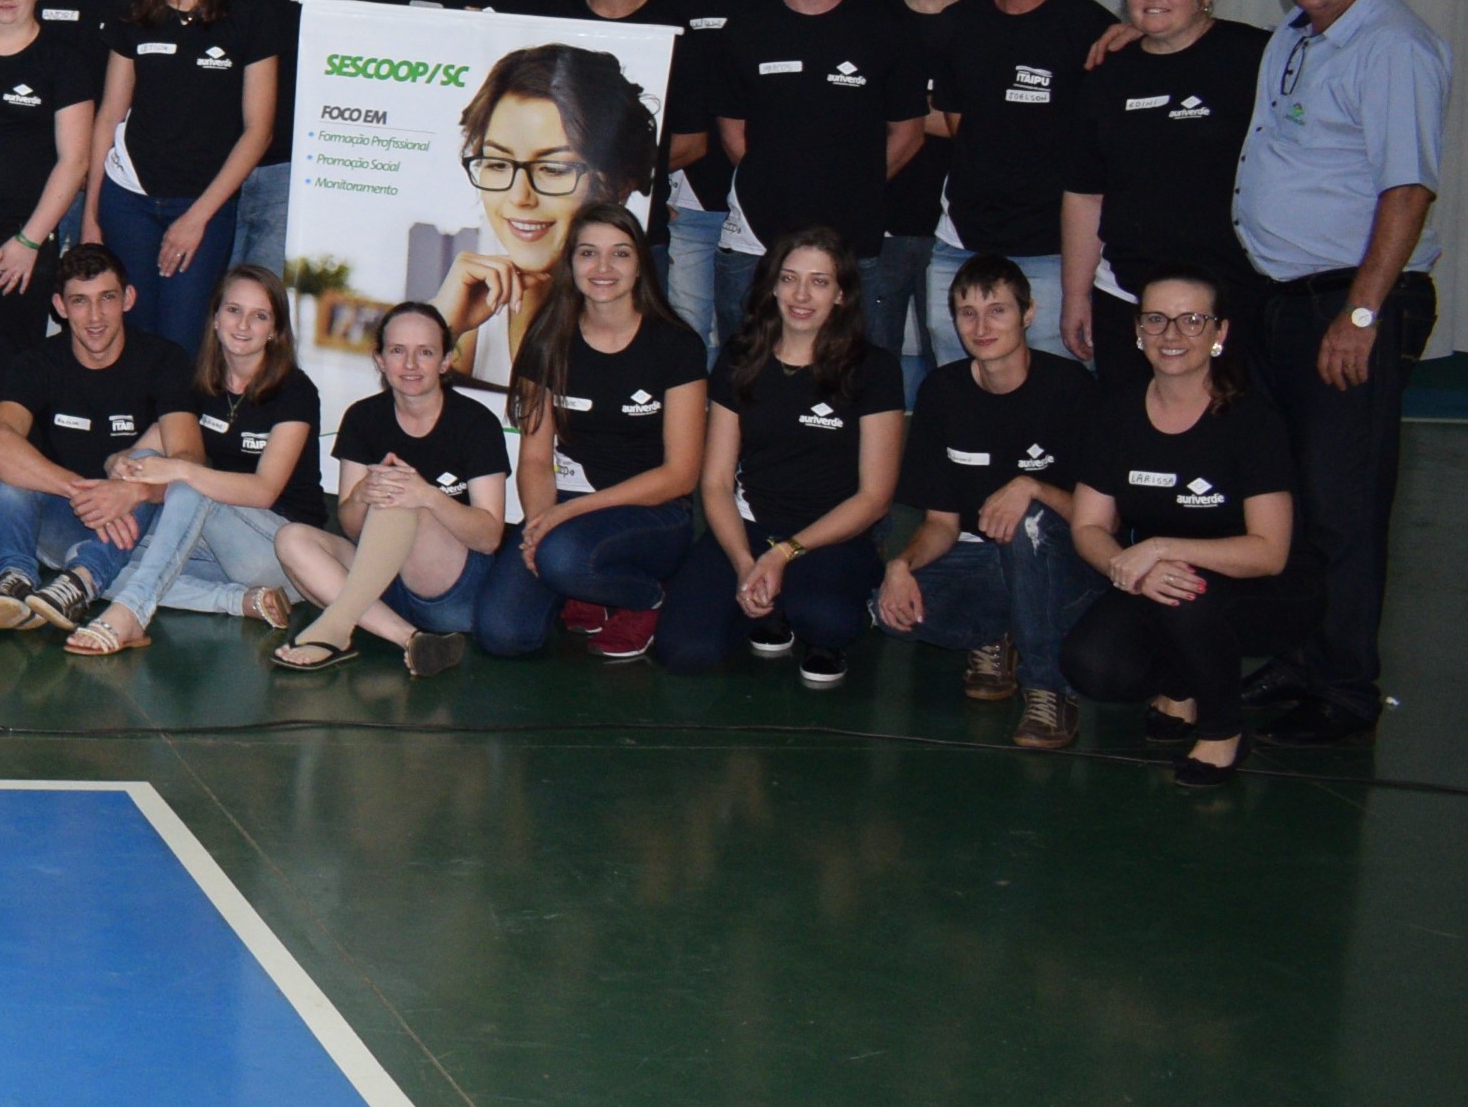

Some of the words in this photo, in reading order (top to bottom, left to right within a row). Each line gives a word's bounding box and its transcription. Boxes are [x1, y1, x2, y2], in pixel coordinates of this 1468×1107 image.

[324, 53, 470, 88] SESCOOP/SC
[1016, 73, 1050, 86] ITAIPU
[321, 105, 362, 122] FOCO
[363, 109, 388, 125] EM
[1168, 107, 1210, 118] auriverde
[318, 130, 370, 148] Formação
[371, 136, 431, 151] Profissional
[316, 153, 370, 171] Promoção
[371, 159, 401, 172] Social
[315, 177, 398, 195] Monitoramento
[621, 400, 662, 413] auriverde
[798, 414, 844, 428] auriverde
[1130, 471, 1175, 485] LARISSA
[1177, 493, 1225, 504] auriverde
